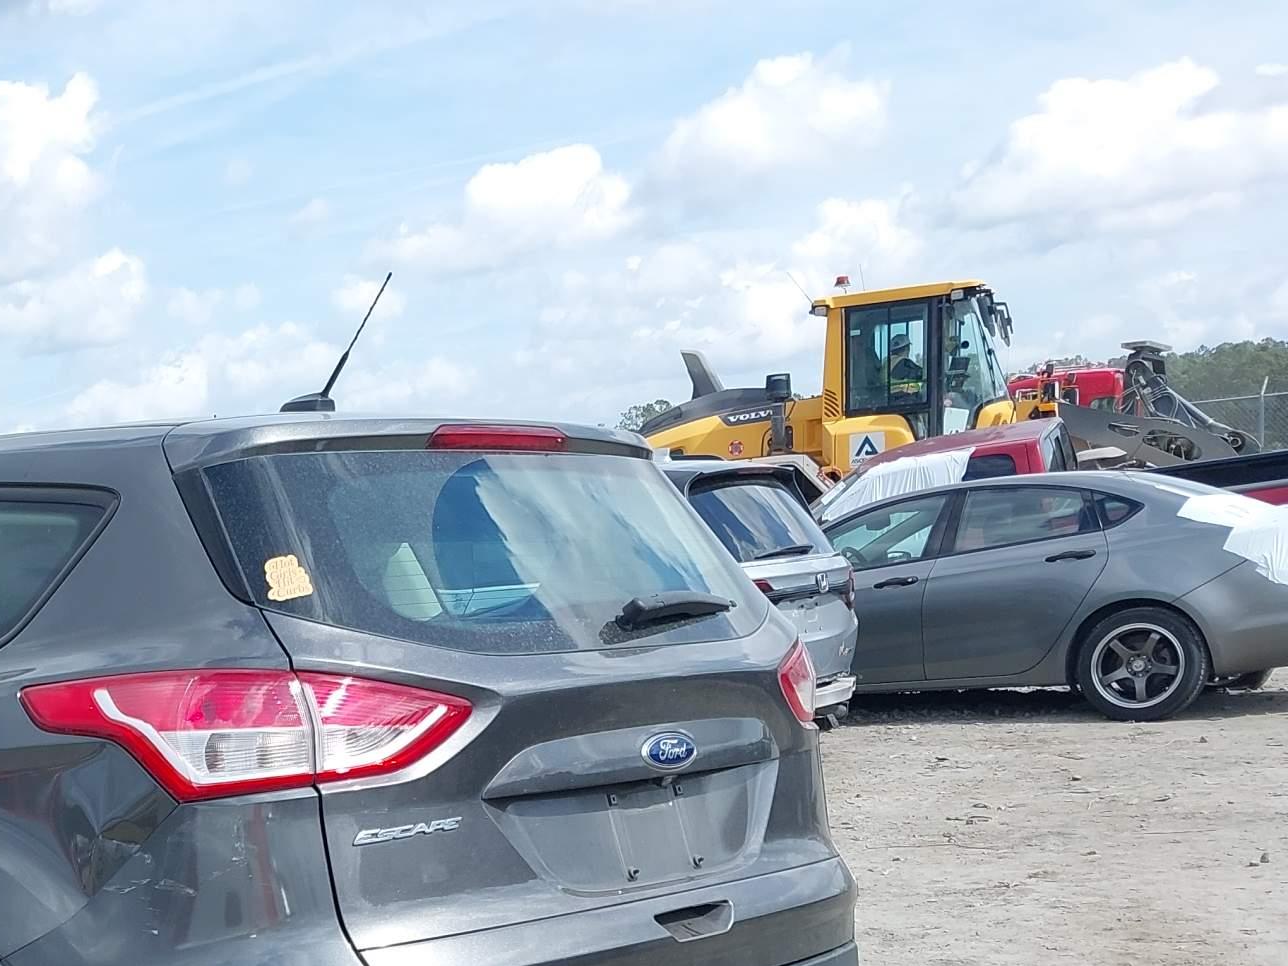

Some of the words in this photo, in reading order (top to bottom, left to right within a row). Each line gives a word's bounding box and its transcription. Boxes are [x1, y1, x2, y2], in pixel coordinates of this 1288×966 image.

[728, 410, 773, 422] VOLV
[659, 739, 688, 761] Ford
[352, 817, 463, 847] ESCAPE
